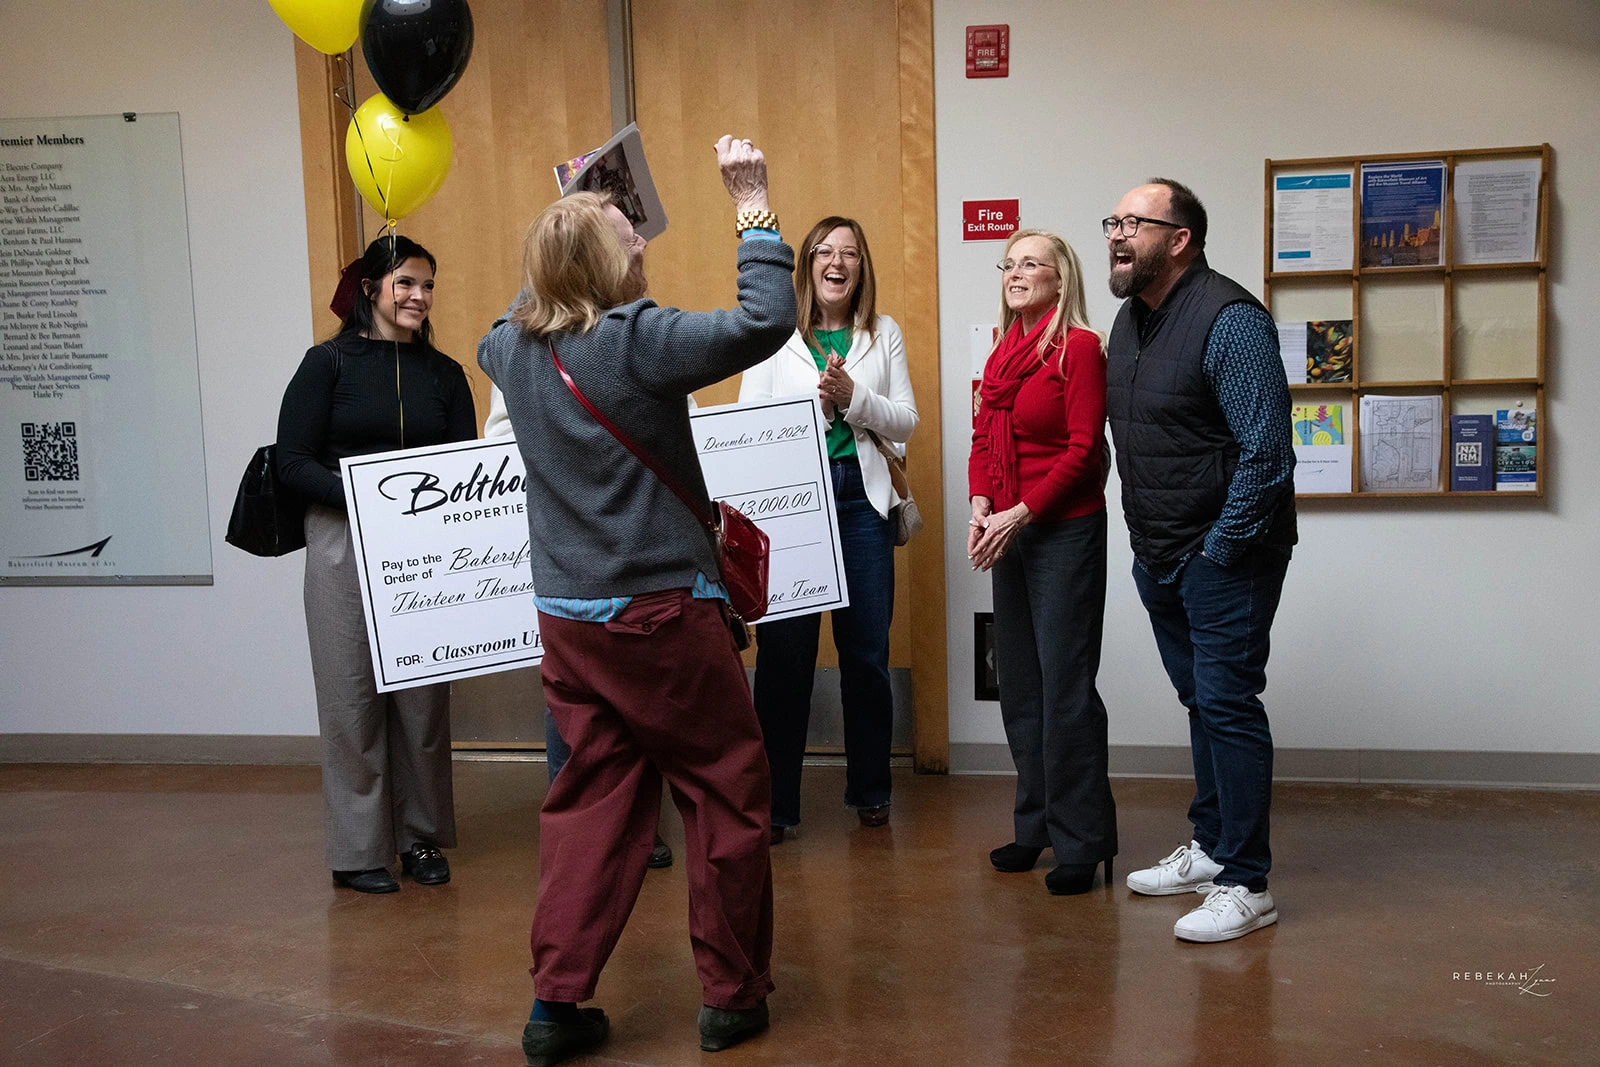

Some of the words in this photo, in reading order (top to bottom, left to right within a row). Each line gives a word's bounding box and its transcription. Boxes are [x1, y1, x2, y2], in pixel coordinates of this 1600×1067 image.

[977, 48, 996, 57] FIRE
[0, 136, 33, 147] remier
[36, 134, 84, 146] Members
[6, 163, 29, 171] Electric
[31, 162, 62, 171] Company
[16, 174, 38, 183] Energy
[4, 206, 18, 214] Way
[978, 209, 1004, 221] Fire
[38, 216, 80, 225] Management
[50, 226, 64, 234] LLC
[968, 223, 986, 232] Exit
[988, 222, 1014, 231] Route
[0, 250, 12, 258] lein
[12, 269, 43, 277] Mountain
[45, 267, 76, 277] Biological
[19, 279, 50, 287] Resources
[51, 278, 90, 288] Corporation
[7, 290, 48, 298] Management
[50, 288, 80, 296] Insurance
[81, 287, 108, 295] Services
[4, 312, 14, 320] Jim
[37, 310, 52, 318] Ford
[53, 310, 78, 318] Lincoln
[48, 321, 62, 329] Rob
[4, 332, 28, 340] Bernard
[30, 332, 36, 340] &
[30, 342, 42, 350] and
[44, 342, 62, 350] Susan
[22, 353, 40, 361] Javier
[50, 352, 70, 360] Laurie
[49, 362, 92, 372] Conditioning
[23, 374, 46, 382] Wealth
[47, 374, 88, 382] Management
[89, 372, 110, 382] Group
[12, 382, 36, 390] Premier
[55, 382, 80, 390] Services
[704, 433, 753, 451] December
[777, 424, 808, 439] 2024
[443, 504, 527, 525] PROPERTIE
[381, 560, 404, 573] Pay
[406, 557, 420, 568] to
[422, 554, 442, 564] the
[384, 573, 418, 586] Order
[422, 569, 434, 580] of
[791, 579, 828, 598] Team
[392, 591, 466, 614] Thirteen
[396, 654, 424, 668] FOR:
[432, 636, 516, 662] Classroom
